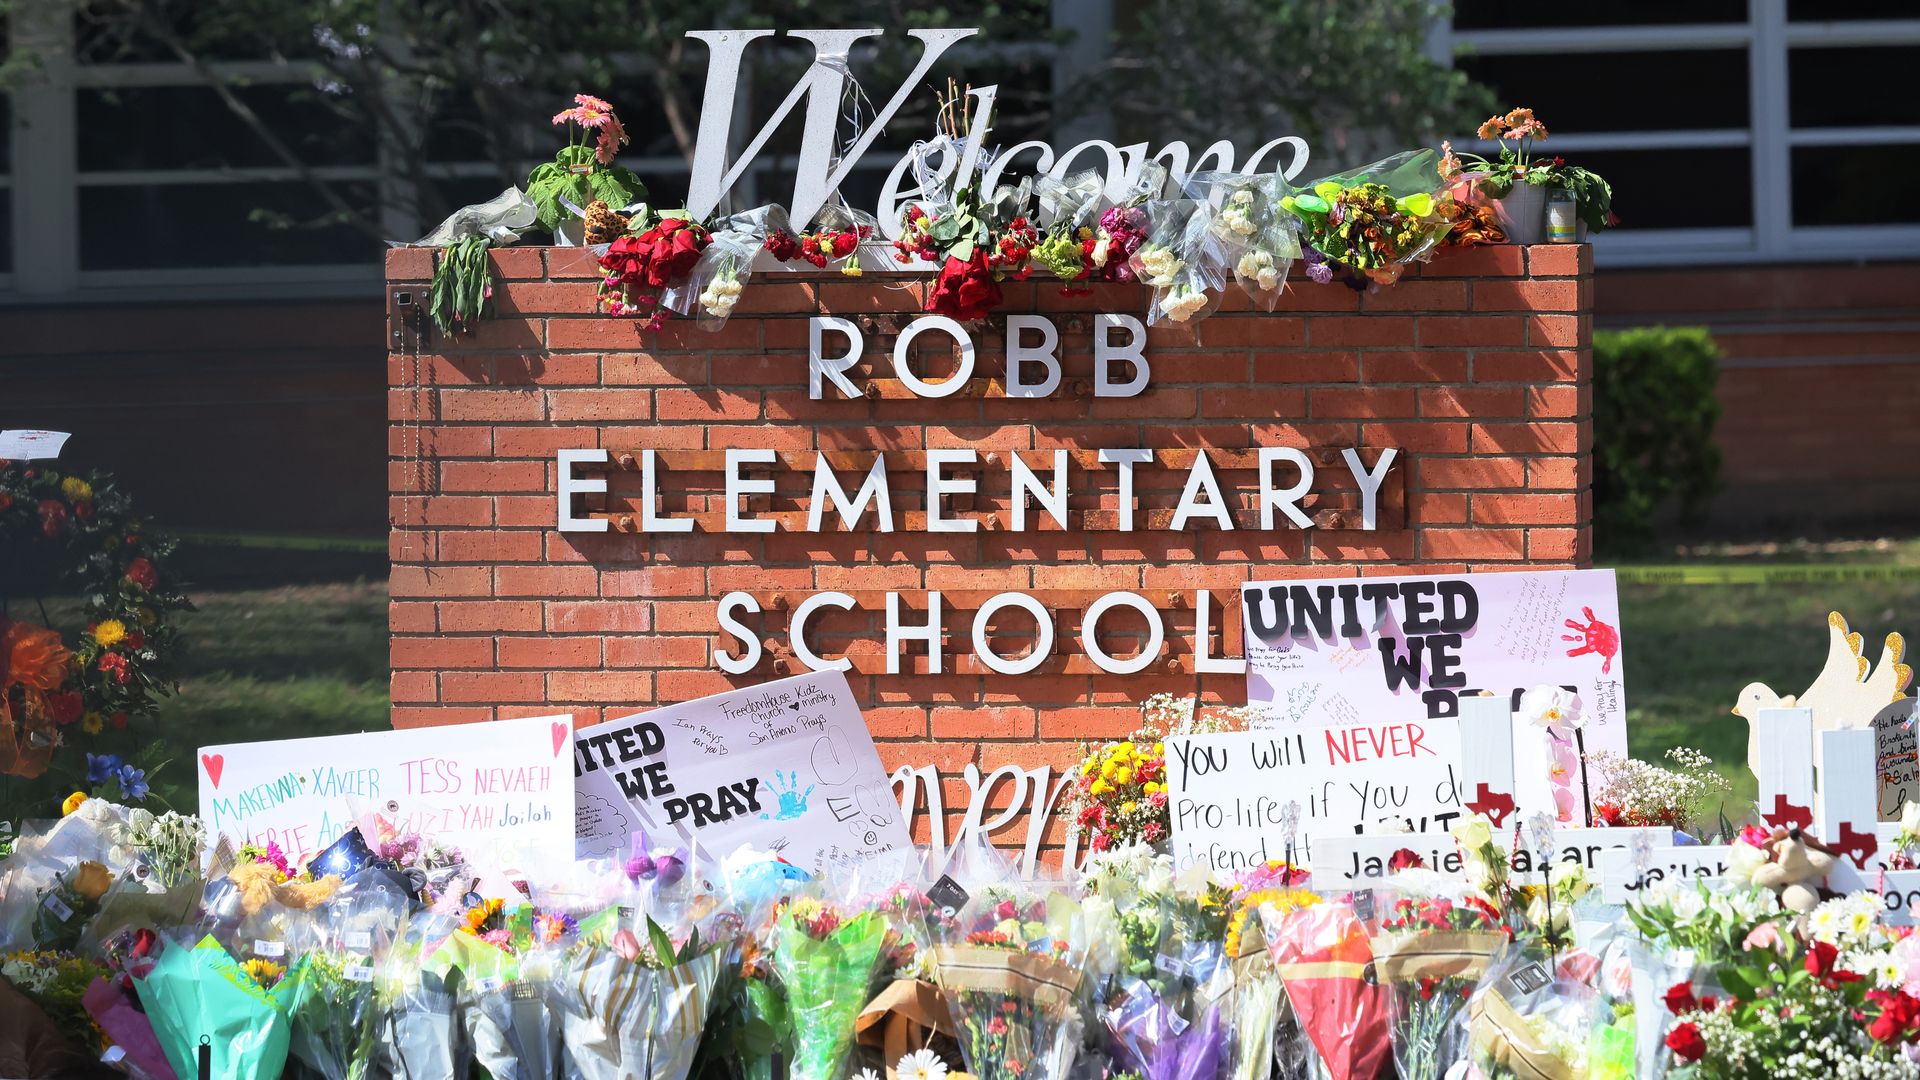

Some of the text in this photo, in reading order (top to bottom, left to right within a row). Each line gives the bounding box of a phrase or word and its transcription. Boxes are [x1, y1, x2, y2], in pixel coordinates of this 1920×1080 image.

[685, 27, 1311, 240] Welcome
[809, 314, 1151, 400] ROBB
[557, 447, 1399, 534] ELEMENTARY
[714, 589, 1246, 677] SCHOOL
[1243, 580, 1479, 640] UNITED
[1378, 633, 1466, 692] WE
[672, 717, 696, 731] Ian
[1325, 722, 1437, 766] NEVER
[311, 766, 380, 799] XAVIER
[399, 757, 462, 795] TESS
[474, 766, 550, 796] NEVAEH
[614, 761, 677, 801] WE
[663, 777, 763, 829] PRAY
[1311, 781, 1336, 817] if
[1344, 849, 1461, 880] Jaie
